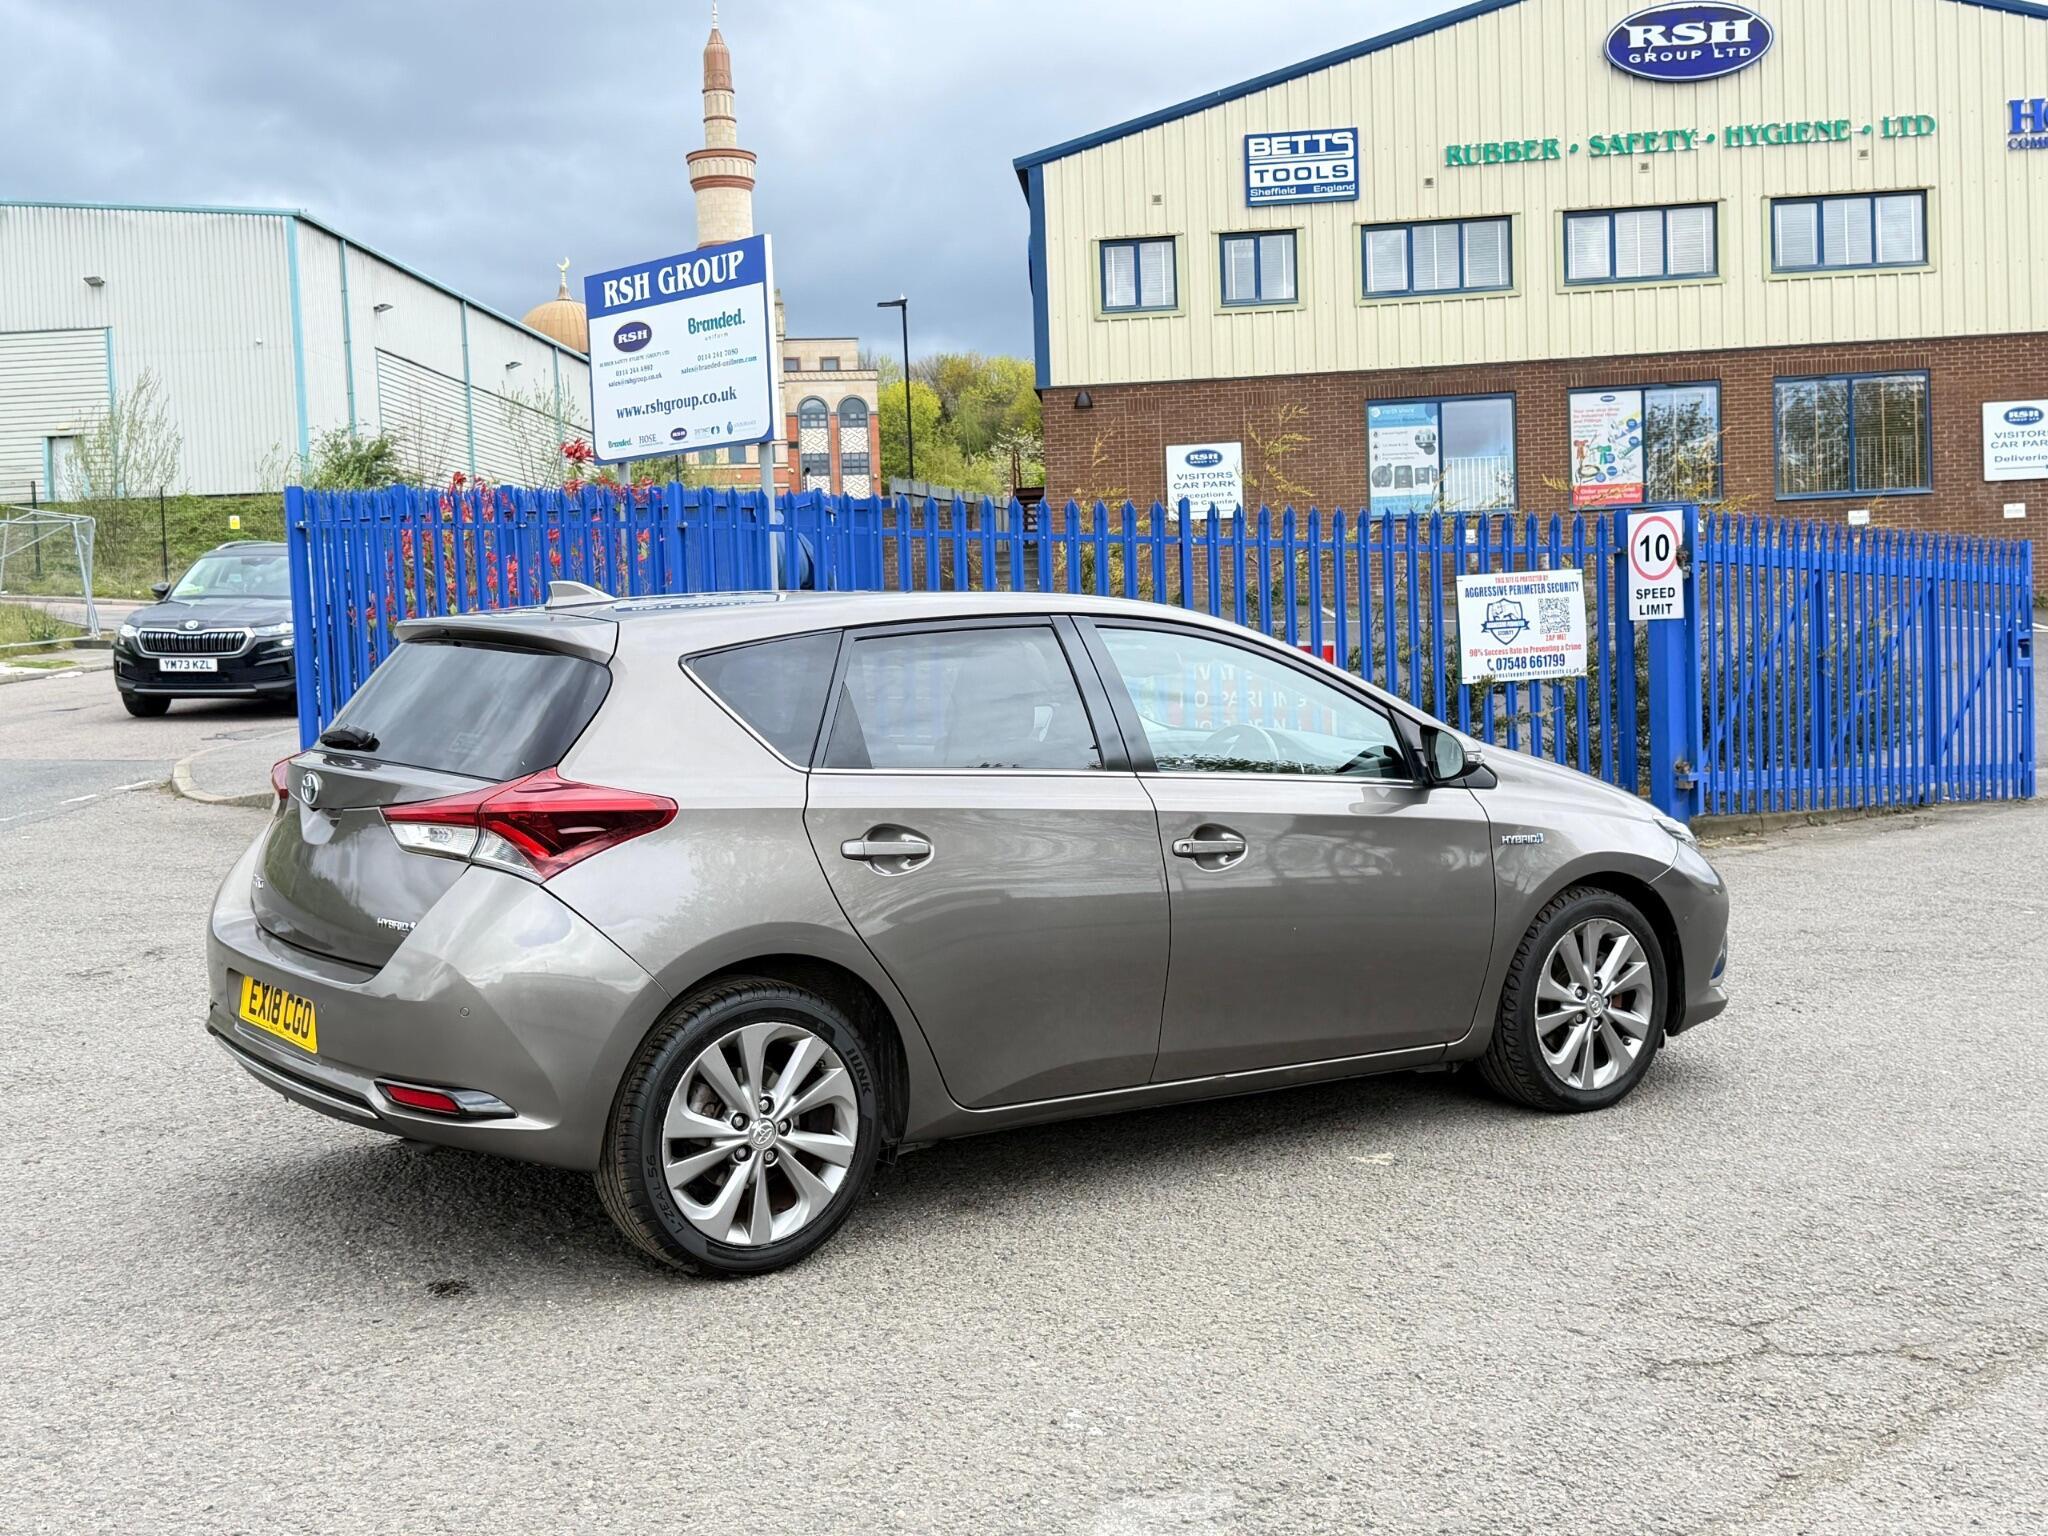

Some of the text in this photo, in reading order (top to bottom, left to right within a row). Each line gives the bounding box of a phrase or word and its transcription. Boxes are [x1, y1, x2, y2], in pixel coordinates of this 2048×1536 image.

[1628, 20, 1751, 48] RSH
[1629, 47, 1750, 64] GROUP LTD
[2006, 99, 2048, 134] H
[1248, 132, 1354, 158] BETTS
[1445, 114, 1936, 167] RUBBER SAFETY HYGIENE LTD
[1254, 164, 1348, 183] TOOLS
[1250, 183, 1355, 197] Sheffield England
[603, 250, 744, 308] RSH GROUP
[688, 308, 745, 334] Branded.
[617, 329, 648, 345] RSH
[616, 386, 737, 419] www.rshgroup.co.uk
[1994, 430, 2048, 439] VISITOR
[1991, 441, 2018, 449] CAR
[1994, 454, 2048, 462] Deliverie
[1177, 472, 1233, 480] VISITORS
[1640, 534, 1669, 562] 10
[1465, 582, 1579, 598] AGGRESSIVE PERIMETER SECURITY
[1636, 587, 1675, 600] SPEED
[1640, 604, 1672, 615] LIMIT
[1484, 648, 1508, 656] Success
[1510, 647, 1522, 655] Rate
[1530, 645, 1559, 653] Preventing
[165, 660, 212, 669] YM73 KZL
[1496, 653, 1565, 670] 07548 661799
[1502, 834, 1537, 844] HYBRID
[377, 917, 409, 931] HYBRID
[249, 979, 312, 1039] EX18 CGO
